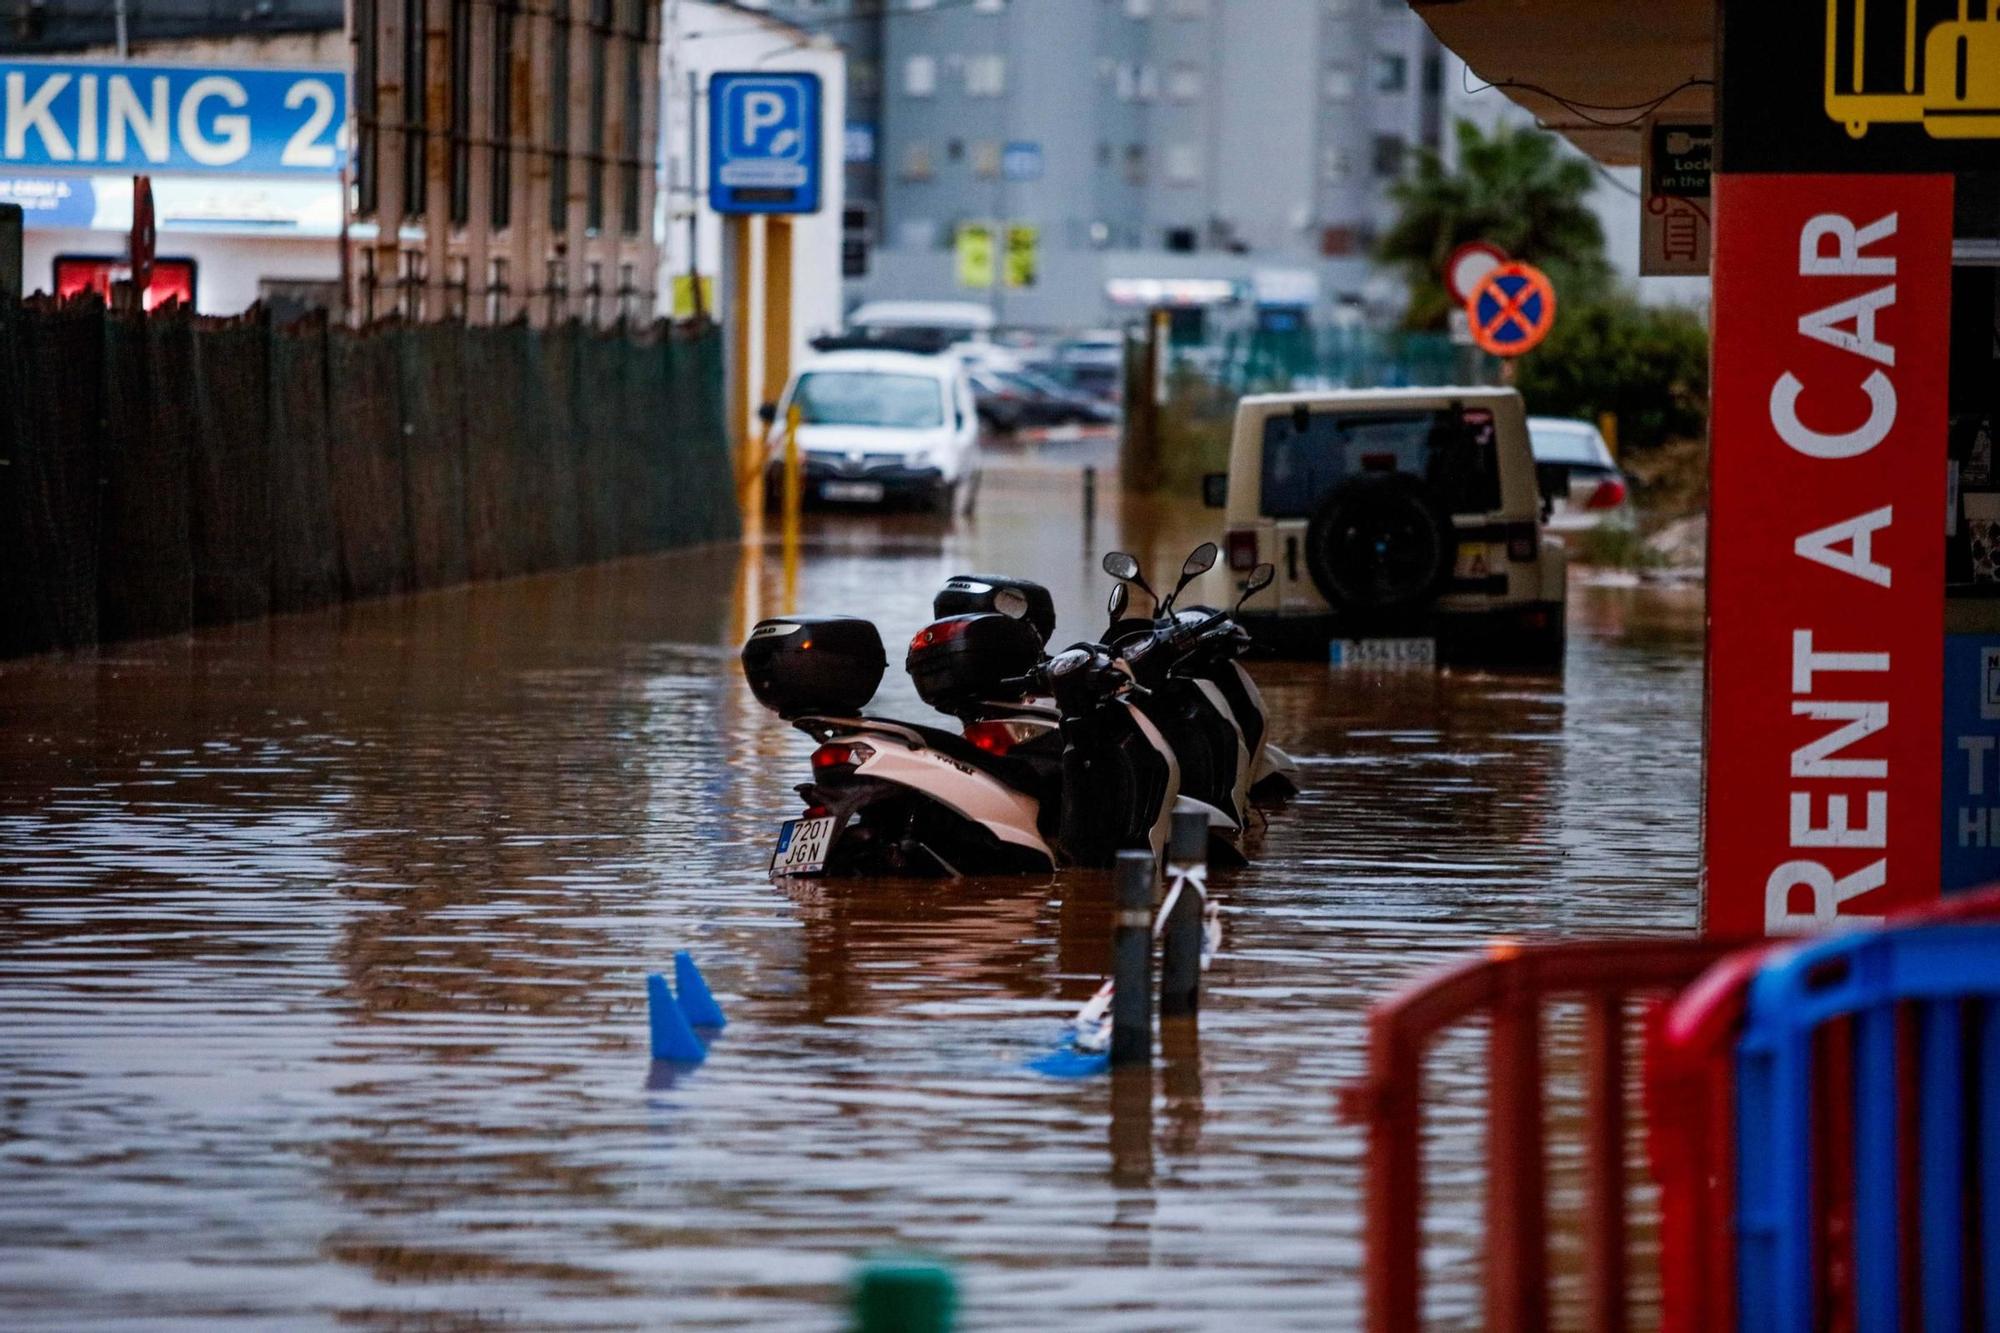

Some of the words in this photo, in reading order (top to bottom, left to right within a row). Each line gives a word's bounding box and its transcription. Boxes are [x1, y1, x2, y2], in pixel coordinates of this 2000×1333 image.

[280, 79, 348, 167] 2
[743, 91, 786, 146] P
[1680, 175, 1705, 187] the
[1769, 210, 1899, 460] CAR
[1794, 505, 1893, 589] A
[1764, 627, 1891, 938] RENT
[1958, 735, 2000, 795] T
[792, 820, 829, 843] 7201
